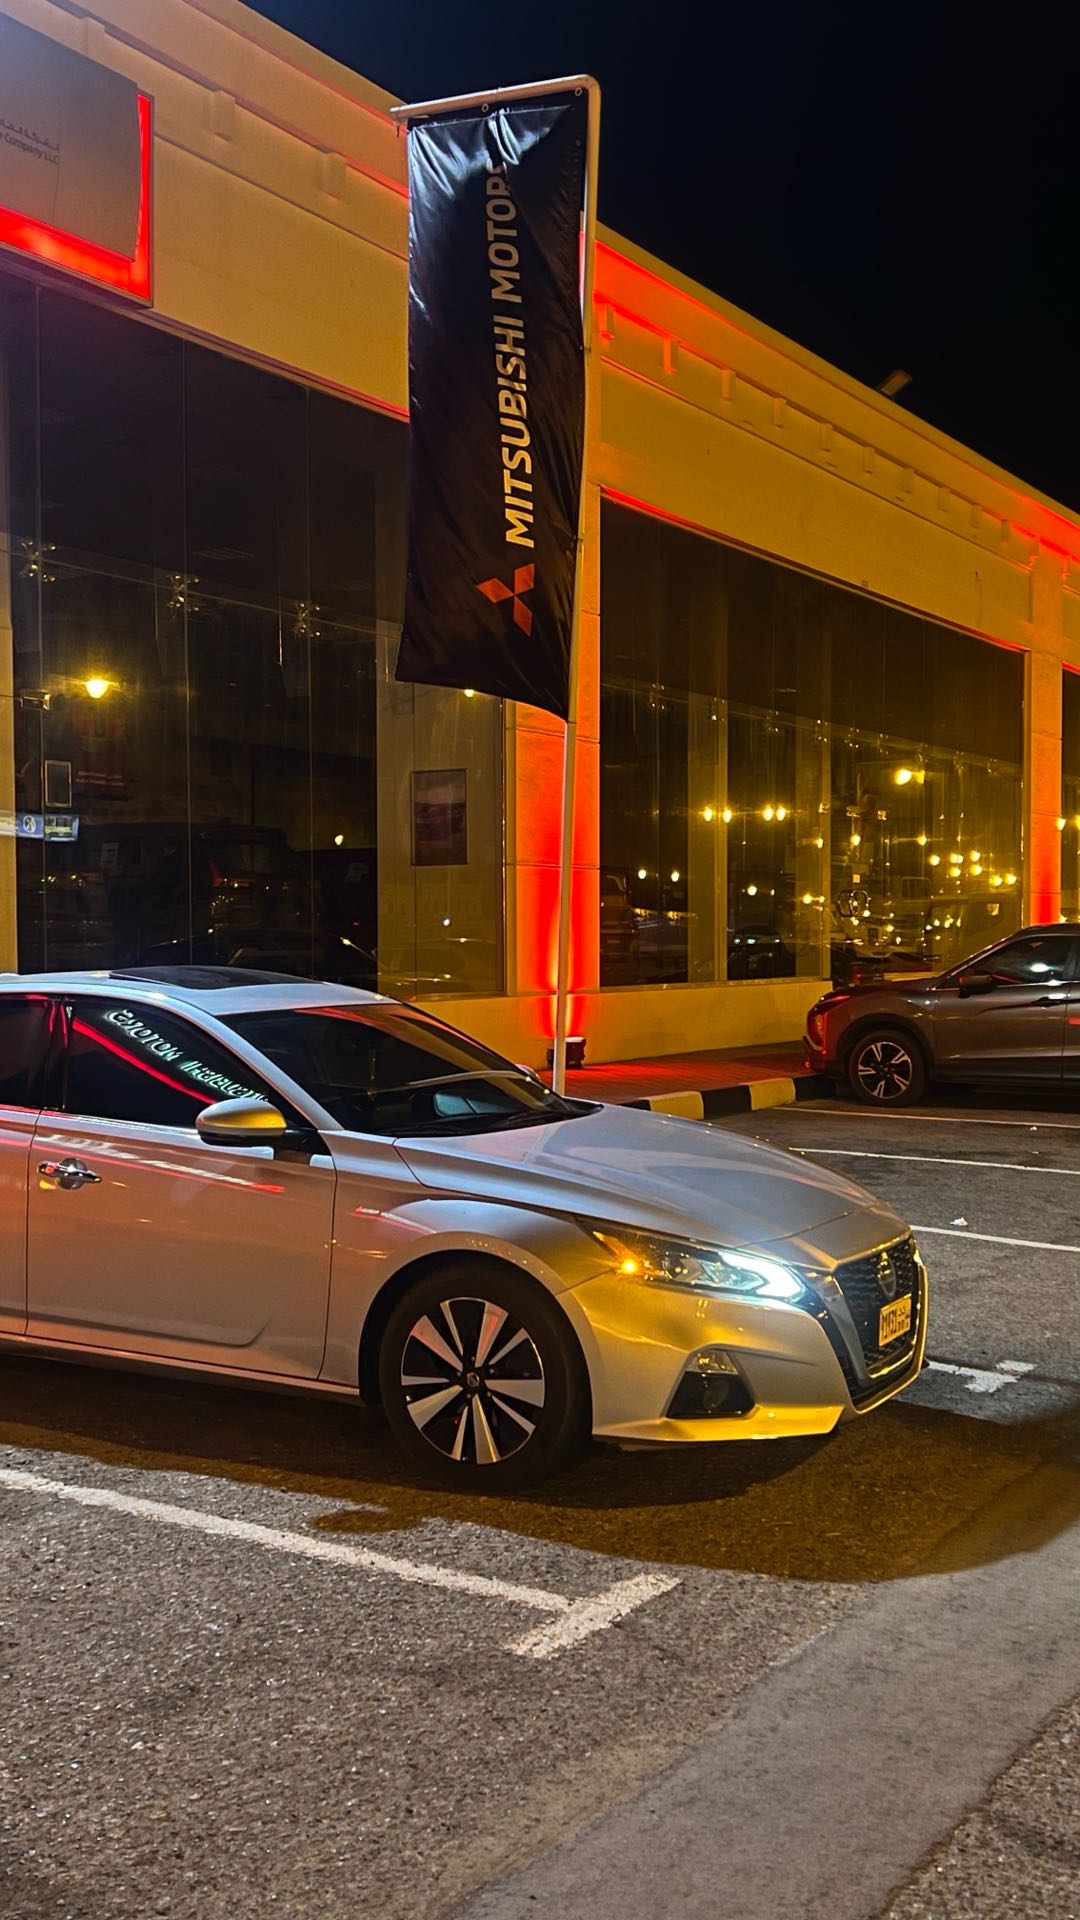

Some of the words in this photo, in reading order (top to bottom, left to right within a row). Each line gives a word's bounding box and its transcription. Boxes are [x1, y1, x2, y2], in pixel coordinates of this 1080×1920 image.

[4, 133, 43, 159] Company
[44, 150, 60, 165] LLC
[495, 315, 534, 548] MITSUBISHI
